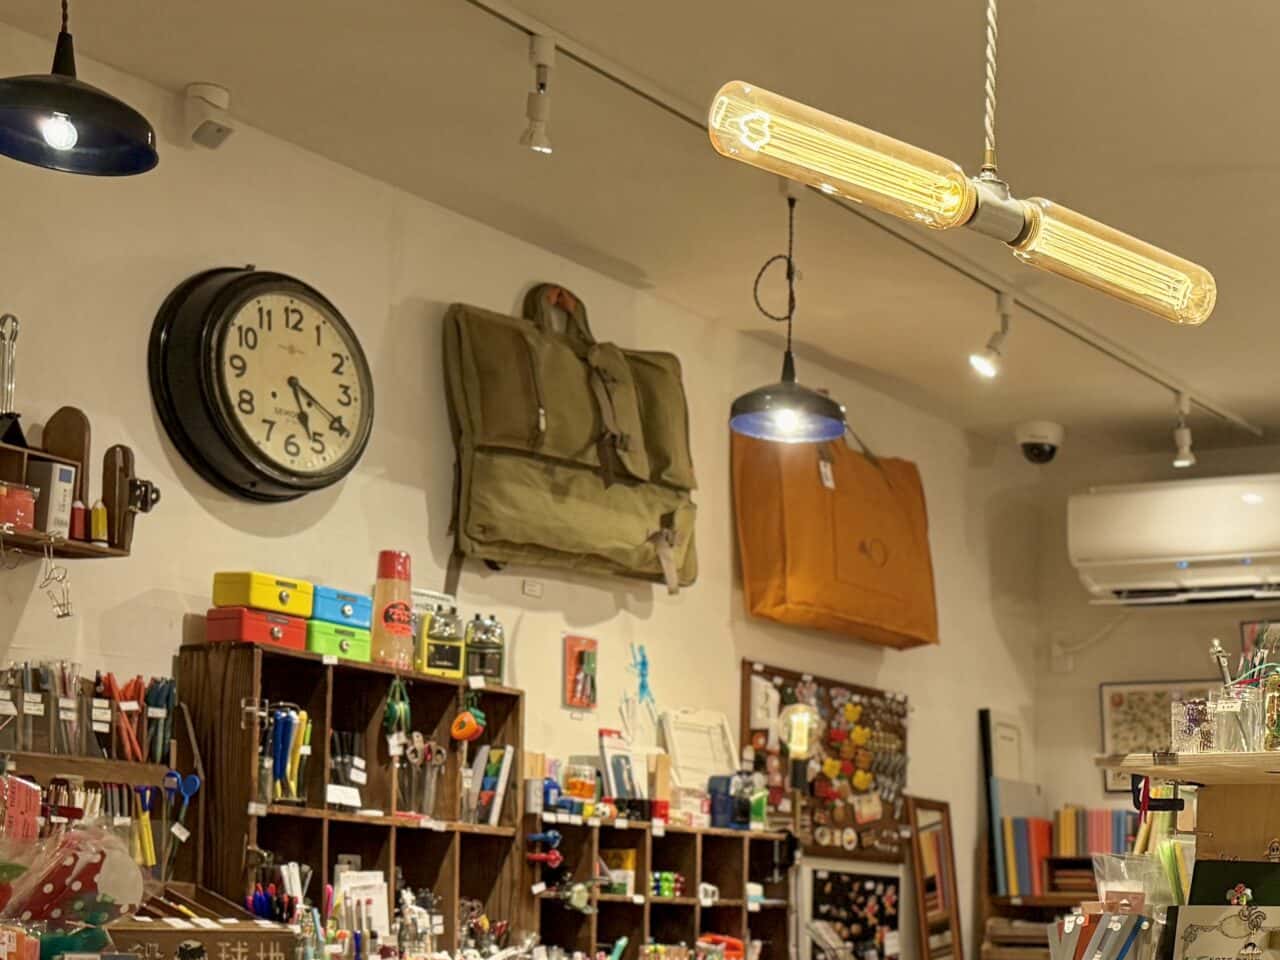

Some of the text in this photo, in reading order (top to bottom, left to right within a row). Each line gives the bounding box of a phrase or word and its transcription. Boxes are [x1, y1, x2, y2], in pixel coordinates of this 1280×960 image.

[257, 306, 272, 332] 11
[284, 306, 304, 332] 12
[237, 325, 258, 350] 10
[315, 325, 321, 347] 1
[229, 354, 247, 378] 9
[331, 353, 345, 375] 2
[237, 389, 255, 415] 8
[337, 384, 352, 407] 3
[261, 419, 276, 442] 7
[284, 434, 300, 457] 6
[310, 432, 325, 455] 5
